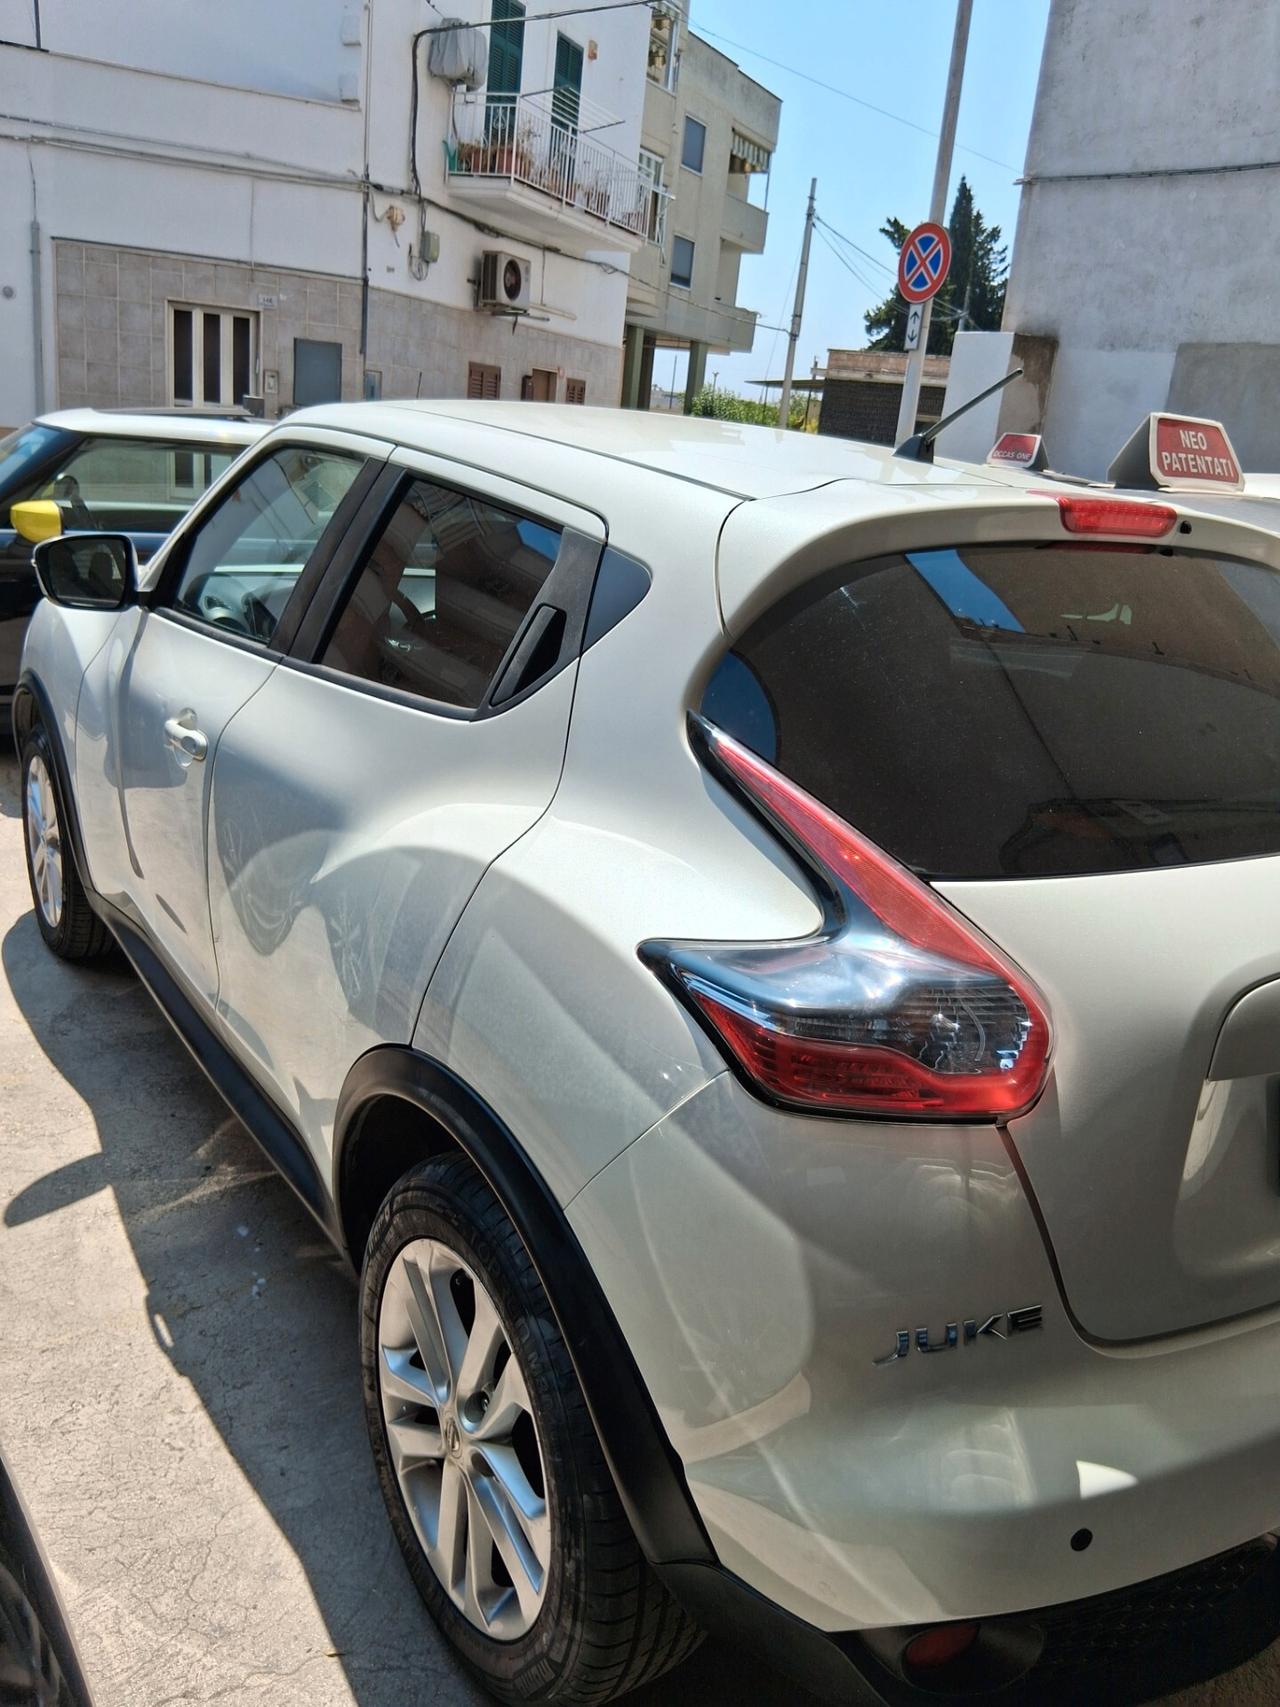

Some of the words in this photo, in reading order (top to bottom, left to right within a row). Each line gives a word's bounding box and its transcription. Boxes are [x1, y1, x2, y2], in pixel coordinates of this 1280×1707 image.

[1179, 429, 1208, 451] NEO
[992, 450, 1033, 461] OCCASONE
[1161, 451, 1235, 478] PATENTATI
[871, 1304, 1043, 1367] JUKE
